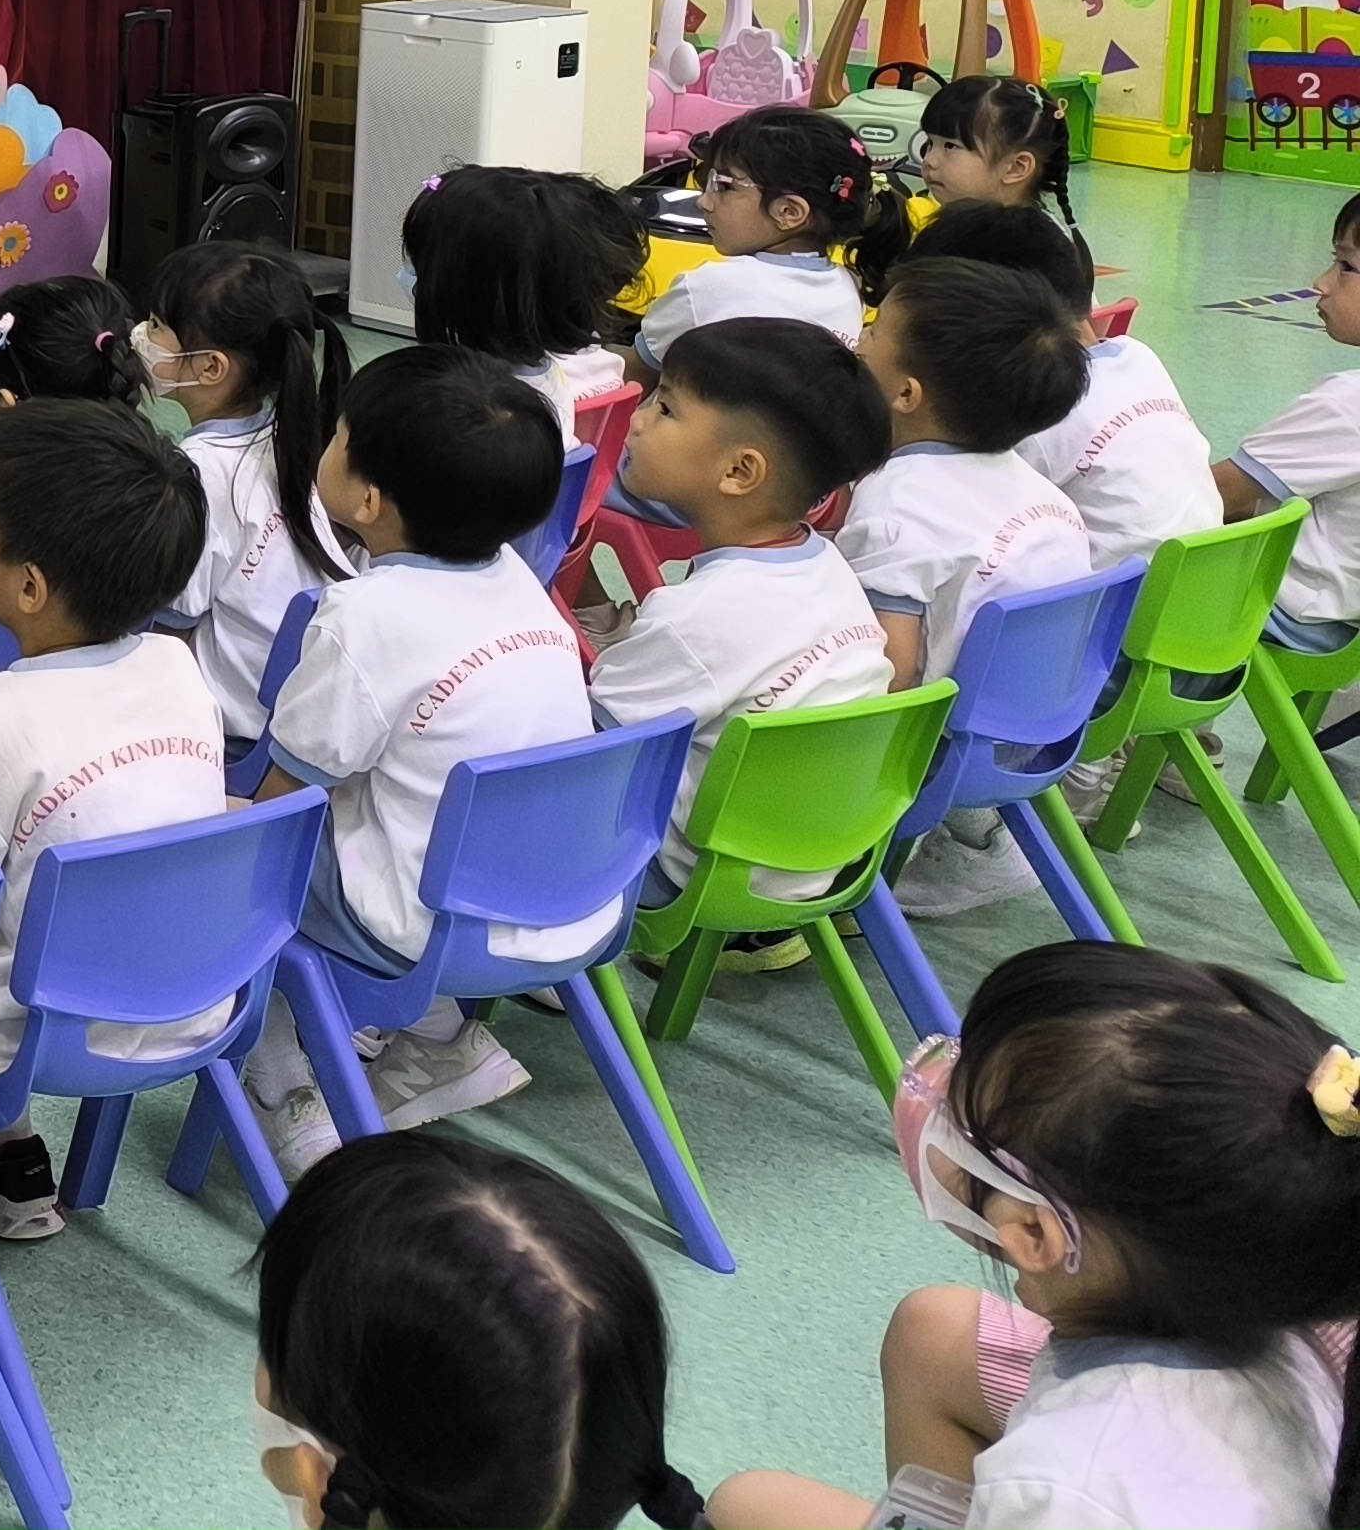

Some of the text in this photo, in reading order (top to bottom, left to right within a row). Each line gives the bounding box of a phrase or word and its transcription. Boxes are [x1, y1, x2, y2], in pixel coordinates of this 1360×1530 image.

[1297, 72, 1320, 99] 2
[409, 643, 494, 736] ACADEMY
[11, 755, 105, 853] ACADEMY
